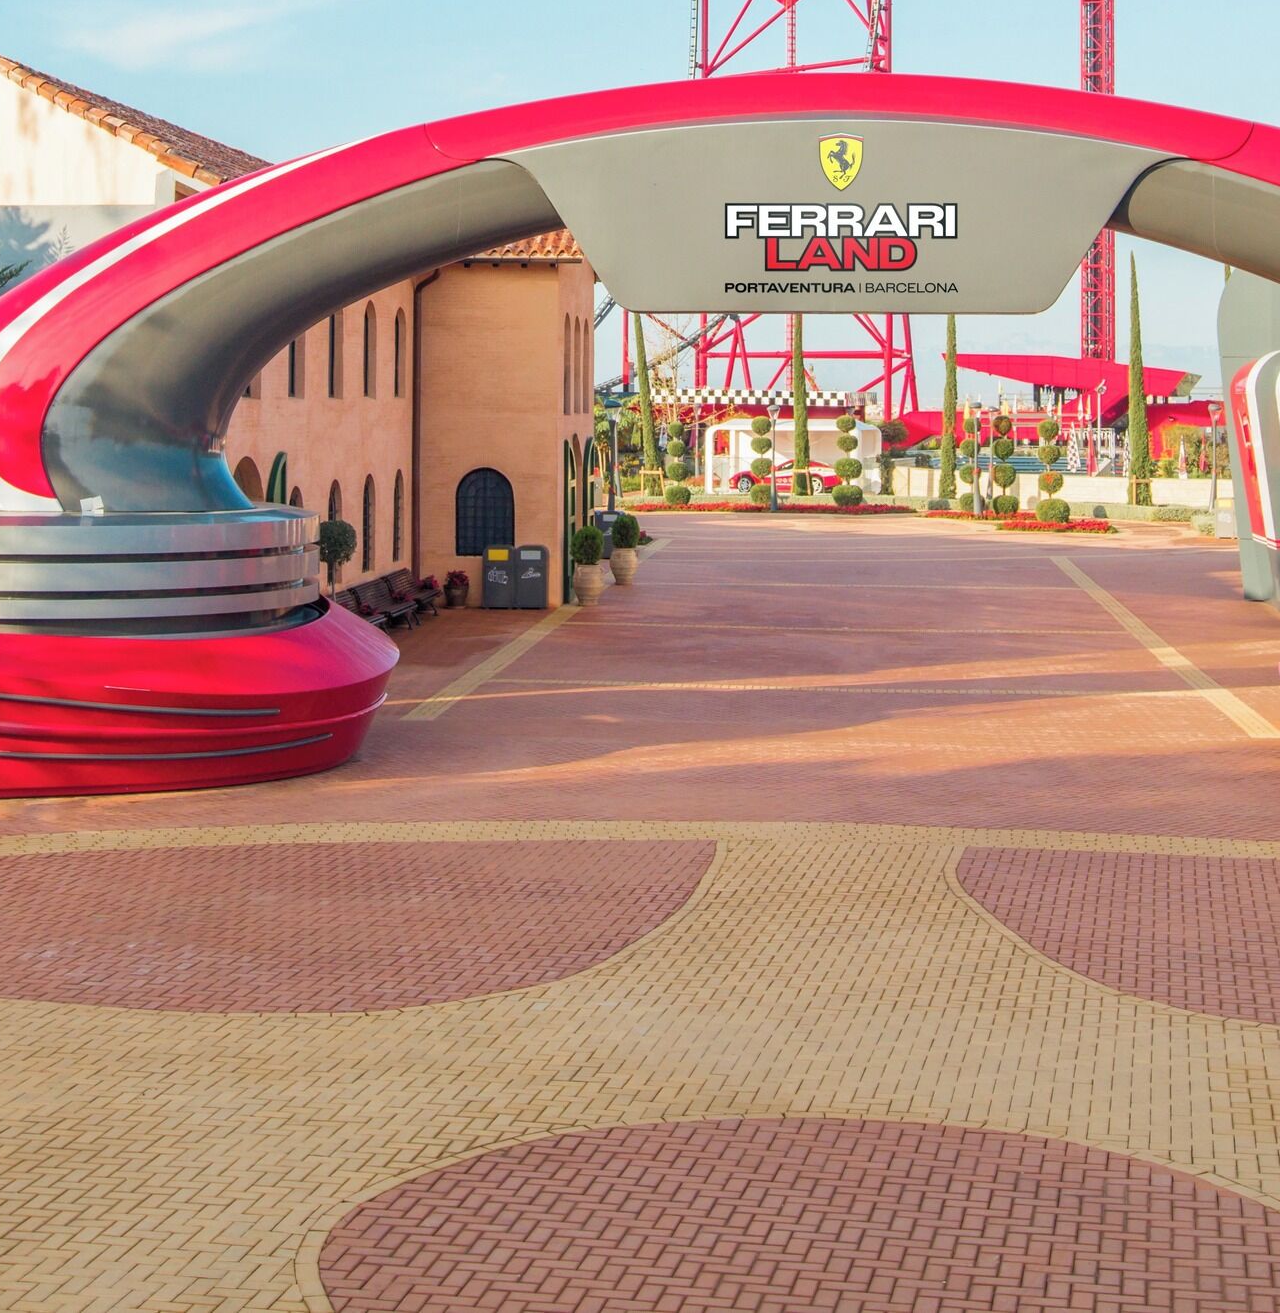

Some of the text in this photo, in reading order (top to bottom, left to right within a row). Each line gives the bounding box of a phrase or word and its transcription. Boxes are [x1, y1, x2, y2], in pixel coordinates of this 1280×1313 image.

[725, 203, 958, 239] FERRARI
[765, 236, 917, 271] LAND
[724, 282, 959, 294] PORTAVENTURA BARCELONA
